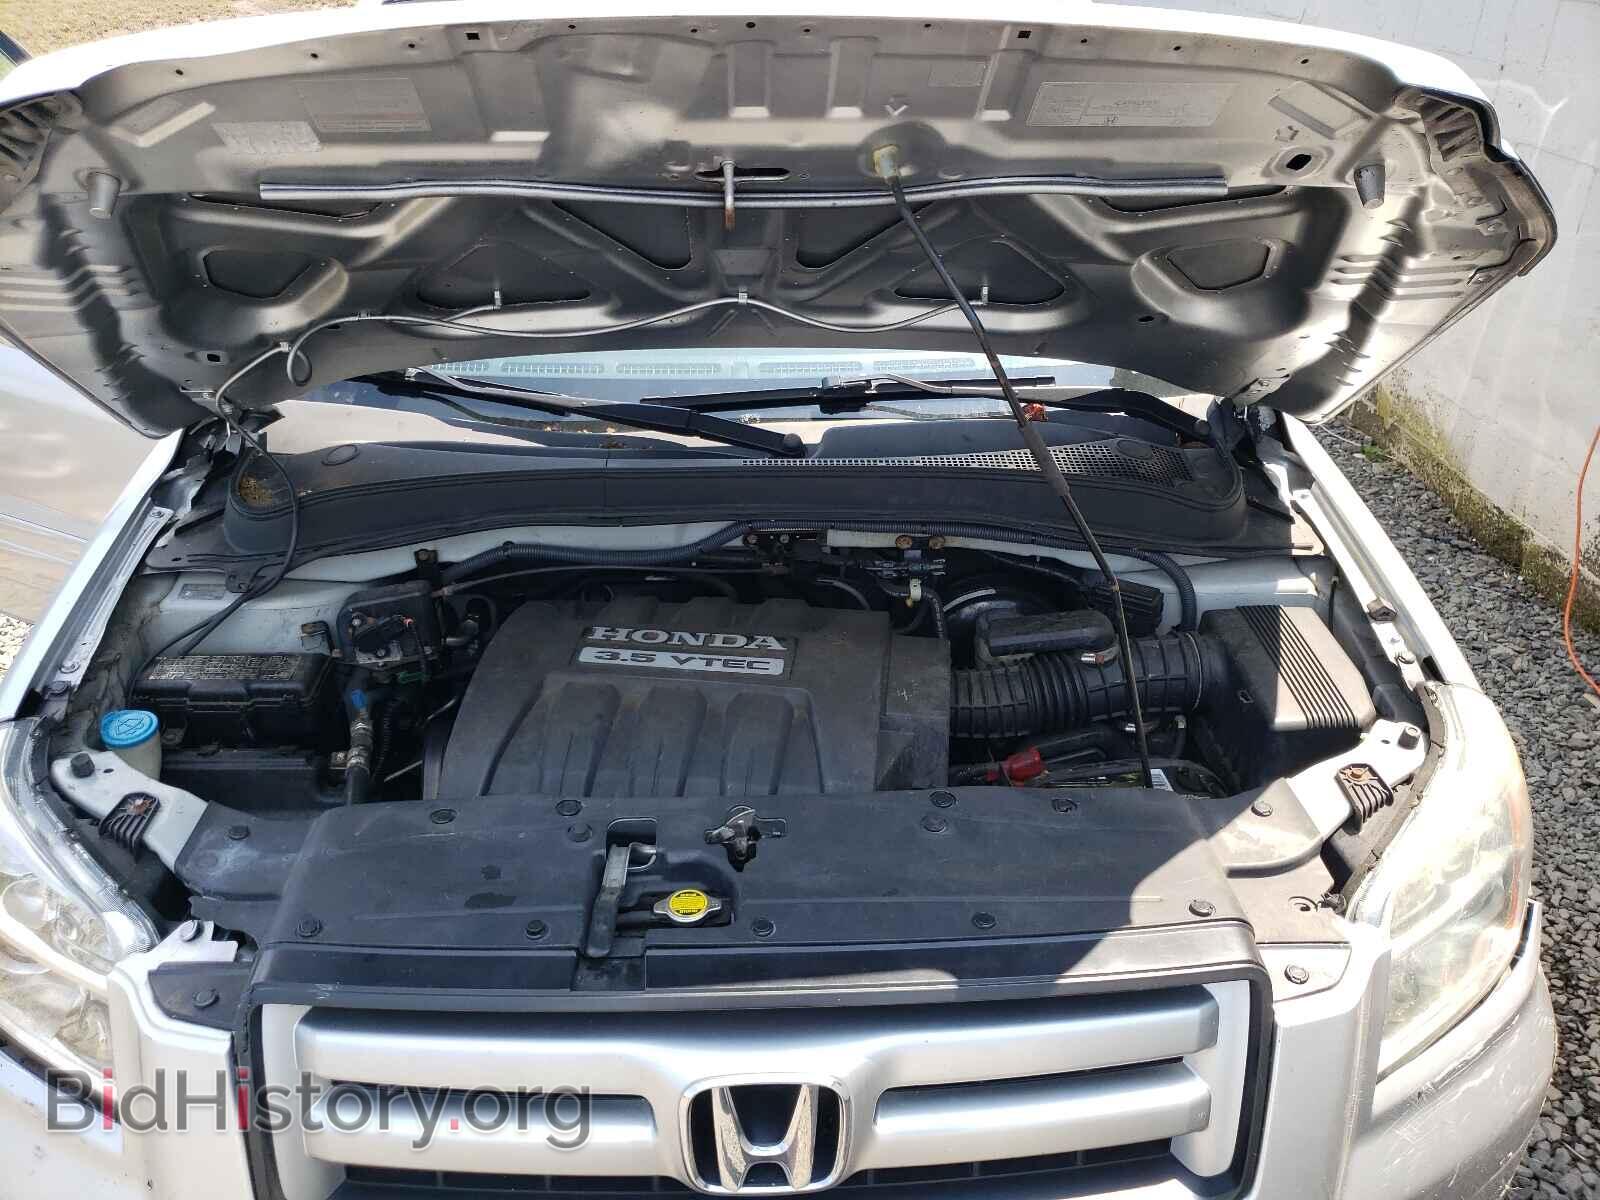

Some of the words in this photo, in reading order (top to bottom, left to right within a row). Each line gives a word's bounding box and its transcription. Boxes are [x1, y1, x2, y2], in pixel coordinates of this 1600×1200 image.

[588, 626, 787, 650] HONDA
[593, 651, 656, 663] 3.5
[670, 654, 771, 671] VTEC
